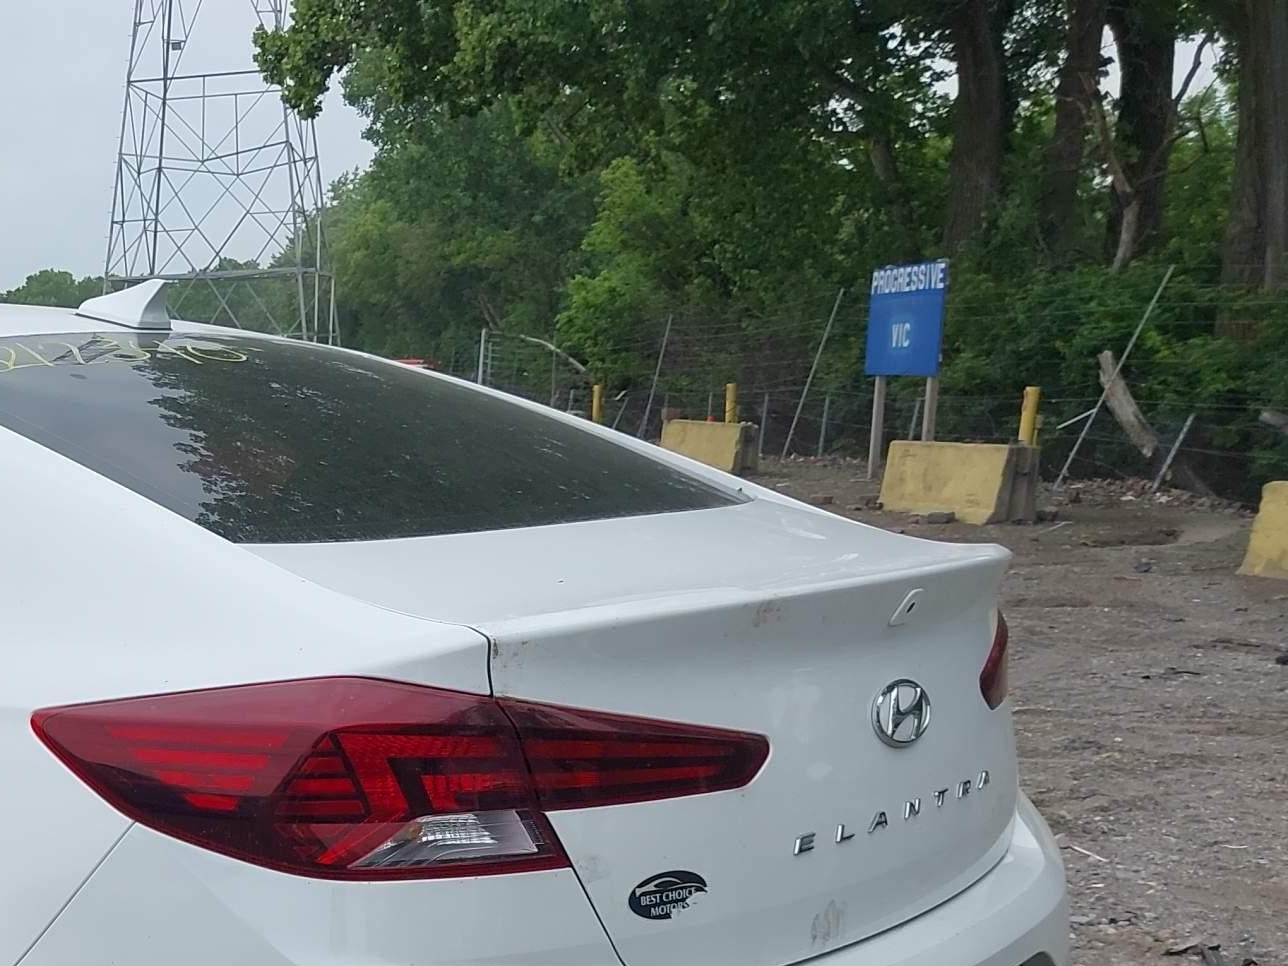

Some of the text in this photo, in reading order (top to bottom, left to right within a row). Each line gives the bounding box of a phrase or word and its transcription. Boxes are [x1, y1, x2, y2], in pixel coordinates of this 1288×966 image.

[871, 262, 946, 295] PROGRESSIVE
[891, 321, 910, 348] VIC
[793, 769, 991, 856] ELANTRA
[640, 893, 661, 906] BEST
